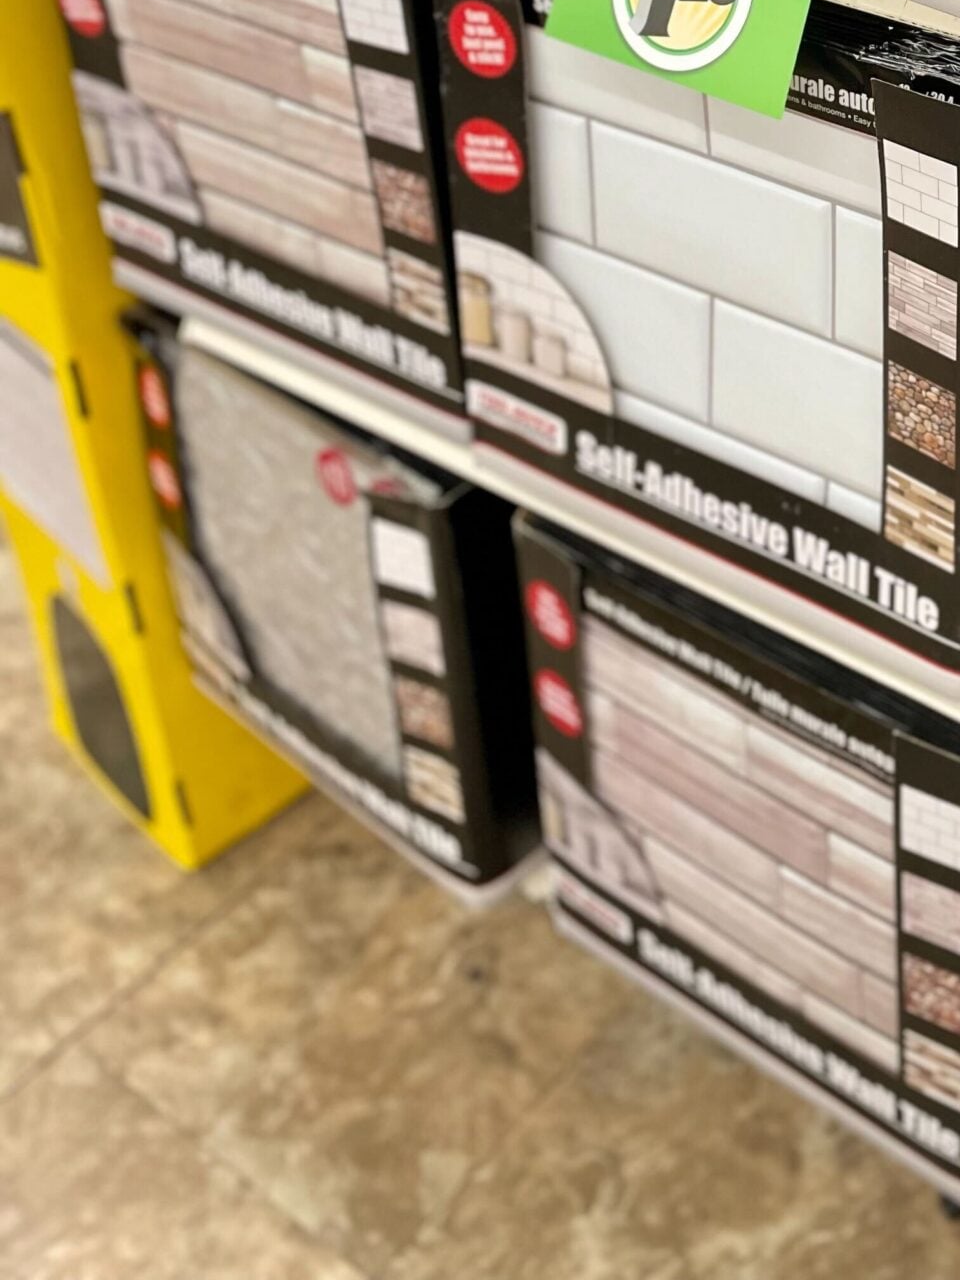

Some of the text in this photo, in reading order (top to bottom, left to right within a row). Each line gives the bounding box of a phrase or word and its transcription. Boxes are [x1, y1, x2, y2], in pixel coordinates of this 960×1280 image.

[808, 101, 846, 119] bathrooms
[853, 114, 872, 128] Easy
[574, 430, 940, 632] Self-Adhesive Wall Tile
